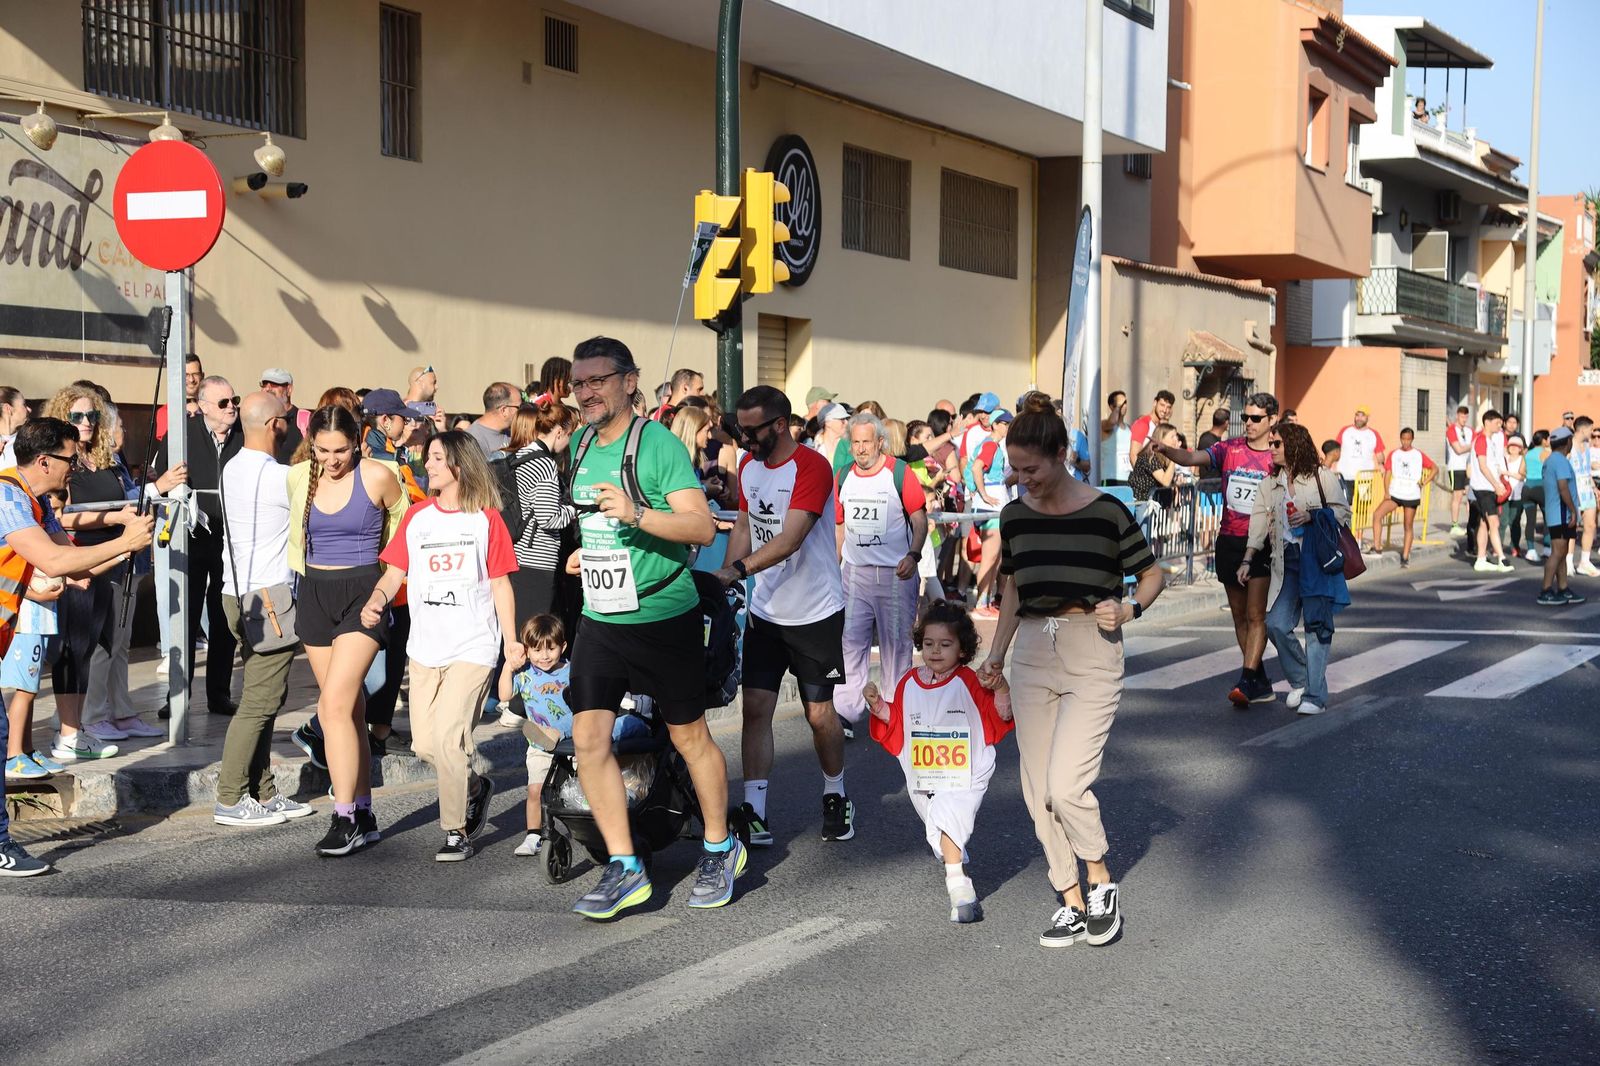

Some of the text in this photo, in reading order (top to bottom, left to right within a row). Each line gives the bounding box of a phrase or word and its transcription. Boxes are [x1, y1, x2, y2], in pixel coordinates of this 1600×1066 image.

[124, 282, 139, 298] EL
[852, 507, 879, 521] 221
[429, 552, 466, 572] 637
[584, 567, 627, 590] 2007
[32, 645, 41, 663] 9
[913, 744, 967, 766] 1086
